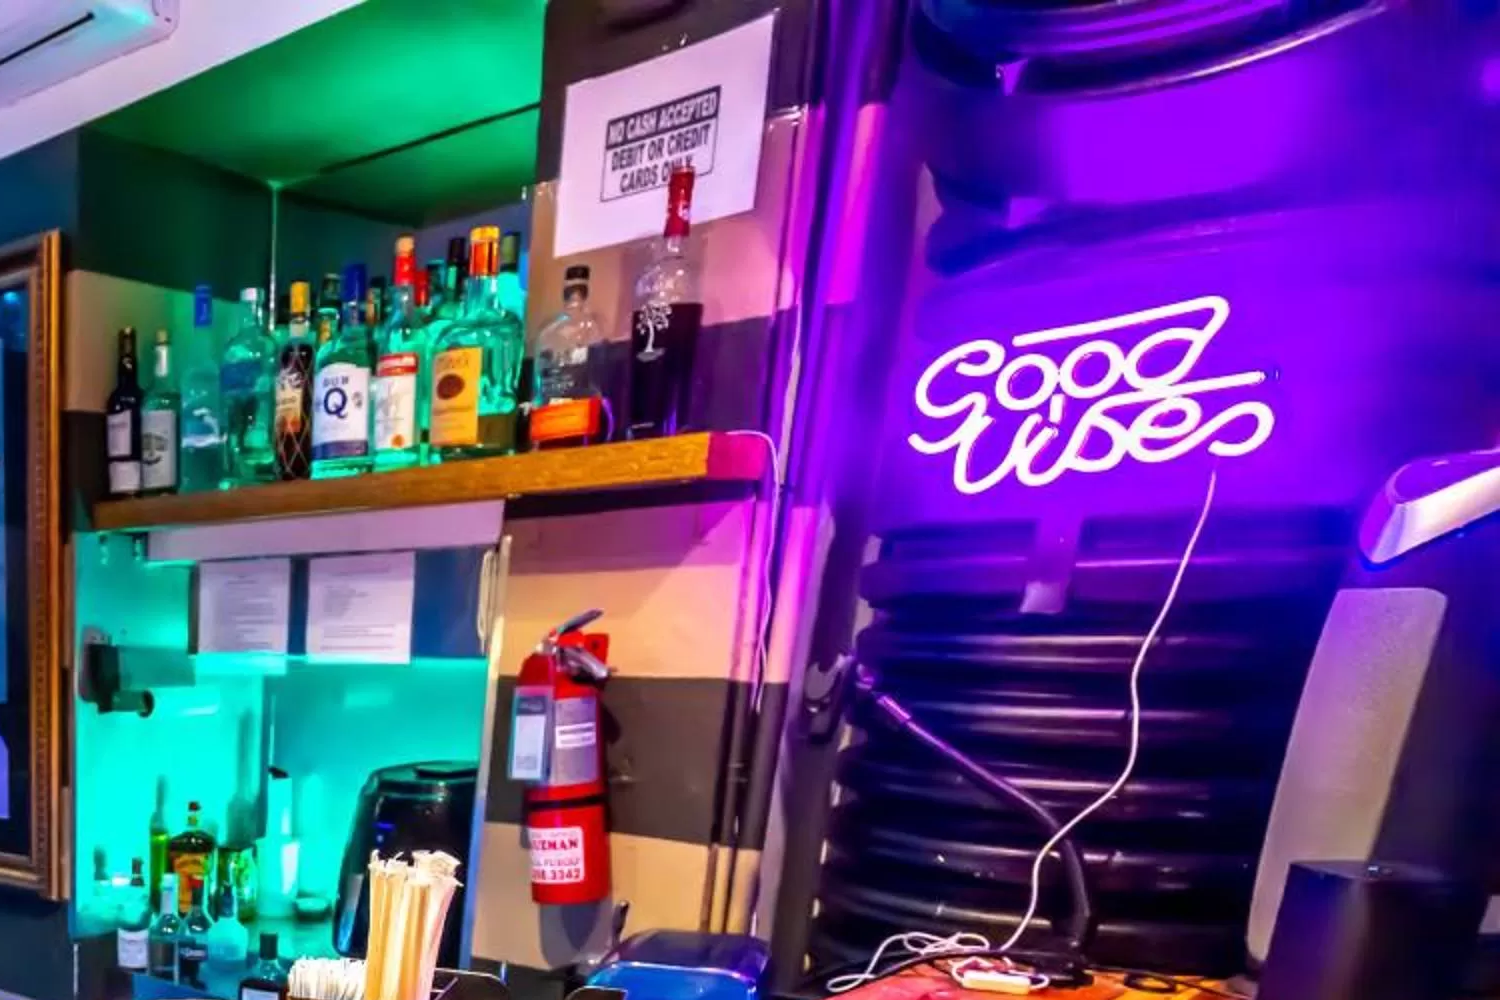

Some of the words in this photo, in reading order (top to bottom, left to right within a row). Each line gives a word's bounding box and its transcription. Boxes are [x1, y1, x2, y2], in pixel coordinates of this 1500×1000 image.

[627, 111, 657, 139] CASH
[659, 93, 716, 129] ACCEPTED
[612, 143, 646, 171] DEBIT
[648, 137, 664, 161] OR
[667, 123, 711, 156] CREDIT
[620, 164, 659, 192] CARDS
[323, 387, 348, 419] Q
